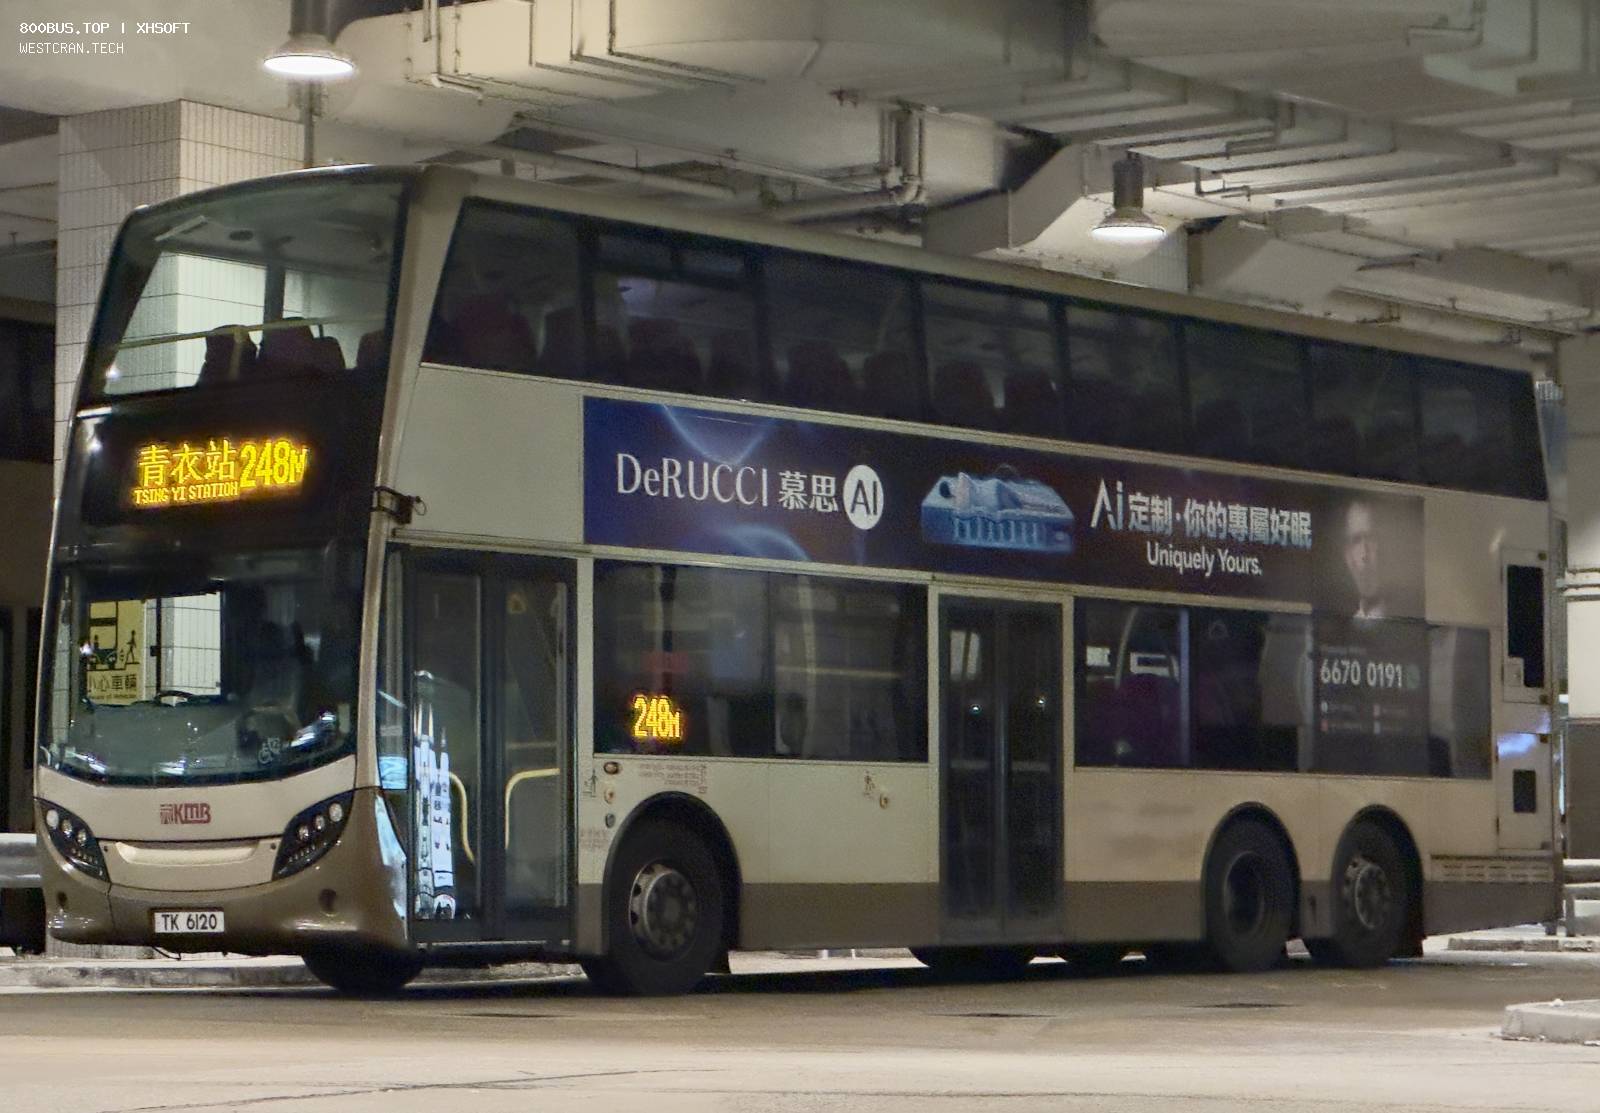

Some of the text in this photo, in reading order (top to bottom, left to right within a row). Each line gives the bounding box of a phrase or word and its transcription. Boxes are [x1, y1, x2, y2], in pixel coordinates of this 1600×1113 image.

[138, 439, 308, 488] 青衣站 248M
[134, 482, 239, 505] TSING YI STATION
[616, 452, 878, 517] DeRUCCI 慕思 AI
[1146, 540, 1263, 578] Uniquely Yours.
[1320, 659, 1403, 688] 6670 0191
[174, 803, 212, 824] KMB
[162, 912, 217, 931] TK 6120
